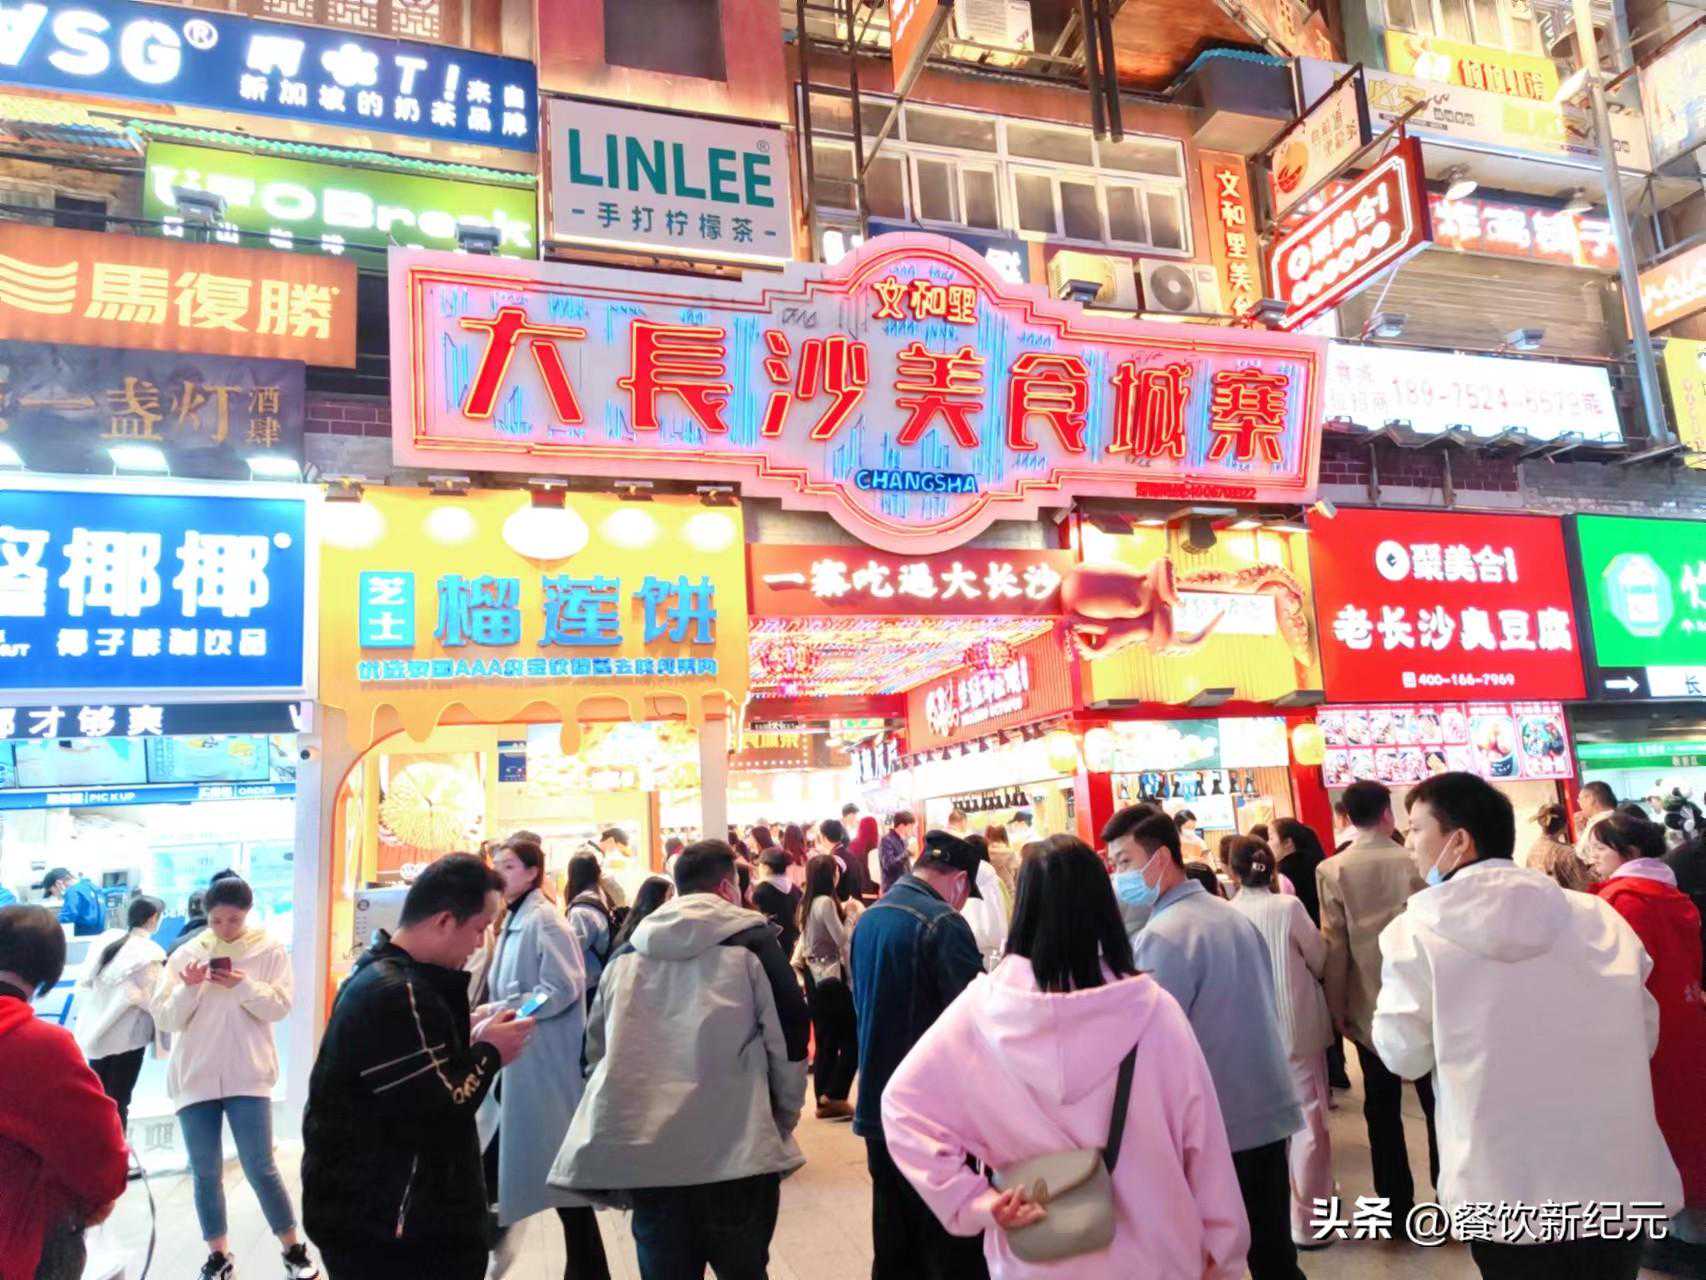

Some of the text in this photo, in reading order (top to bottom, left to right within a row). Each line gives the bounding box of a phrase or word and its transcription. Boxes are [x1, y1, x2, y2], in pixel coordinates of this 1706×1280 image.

[568, 128, 776, 209] LINLEE
[597, 201, 754, 243] 手打柠檬茶
[83, 262, 332, 340] 馬復勝
[18, 376, 242, 443] 一盏灯
[460, 306, 1289, 464] 大長沙美食城寨
[856, 469, 978, 493] CHANGSHA
[367, 576, 407, 642] 芝士
[433, 574, 719, 647] 榴莲饼
[1332, 604, 1573, 652] 老长沙臭豆腐
